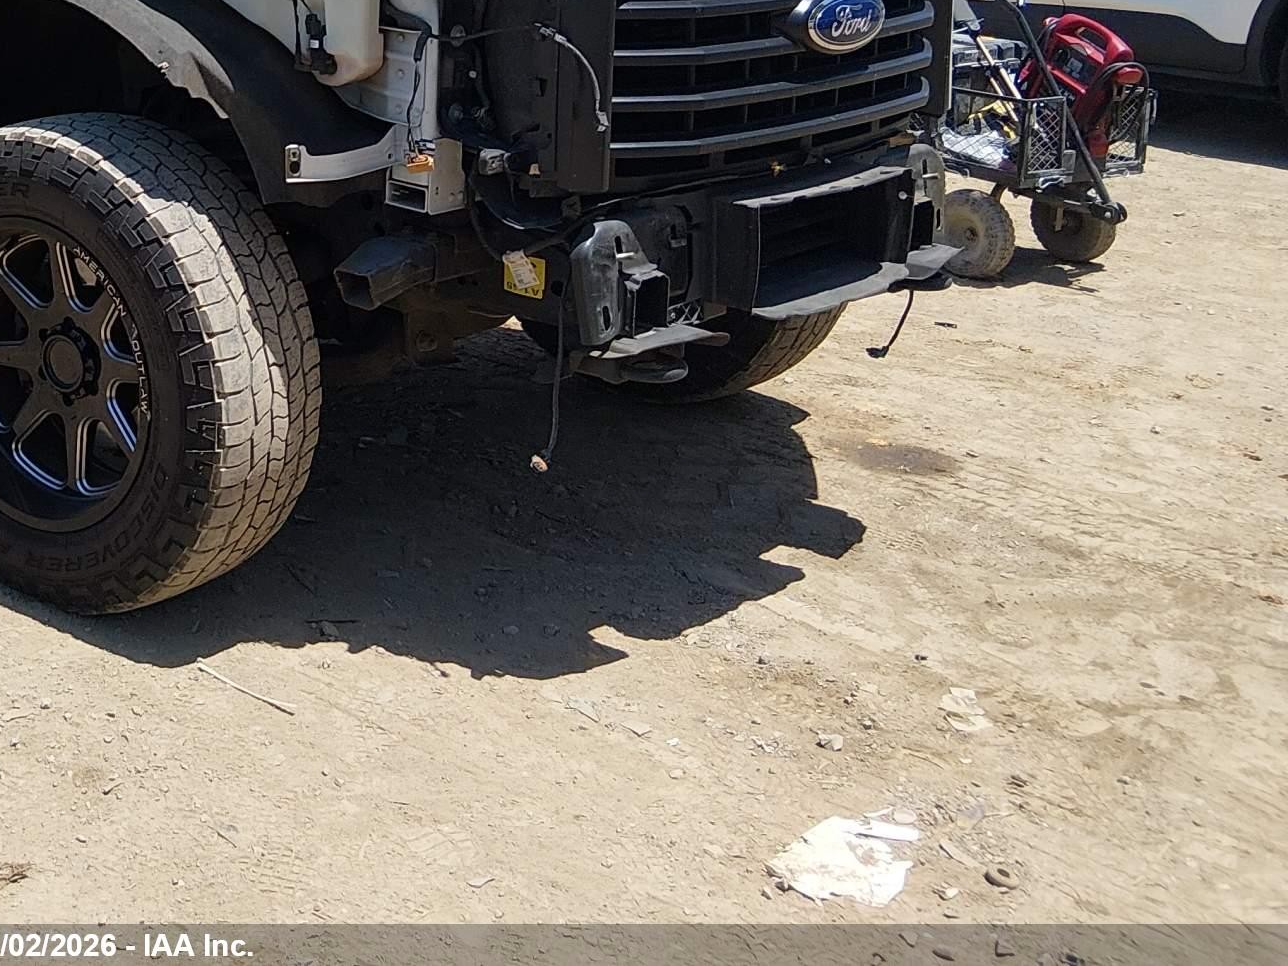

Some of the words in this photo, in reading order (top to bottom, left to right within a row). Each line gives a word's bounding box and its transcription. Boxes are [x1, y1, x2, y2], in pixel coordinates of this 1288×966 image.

[832, 4, 872, 38] Ford
[72, 245, 128, 318] AMERICAN
[131, 340, 151, 415] OUTLAW
[24, 462, 168, 572] DISCOVERER
